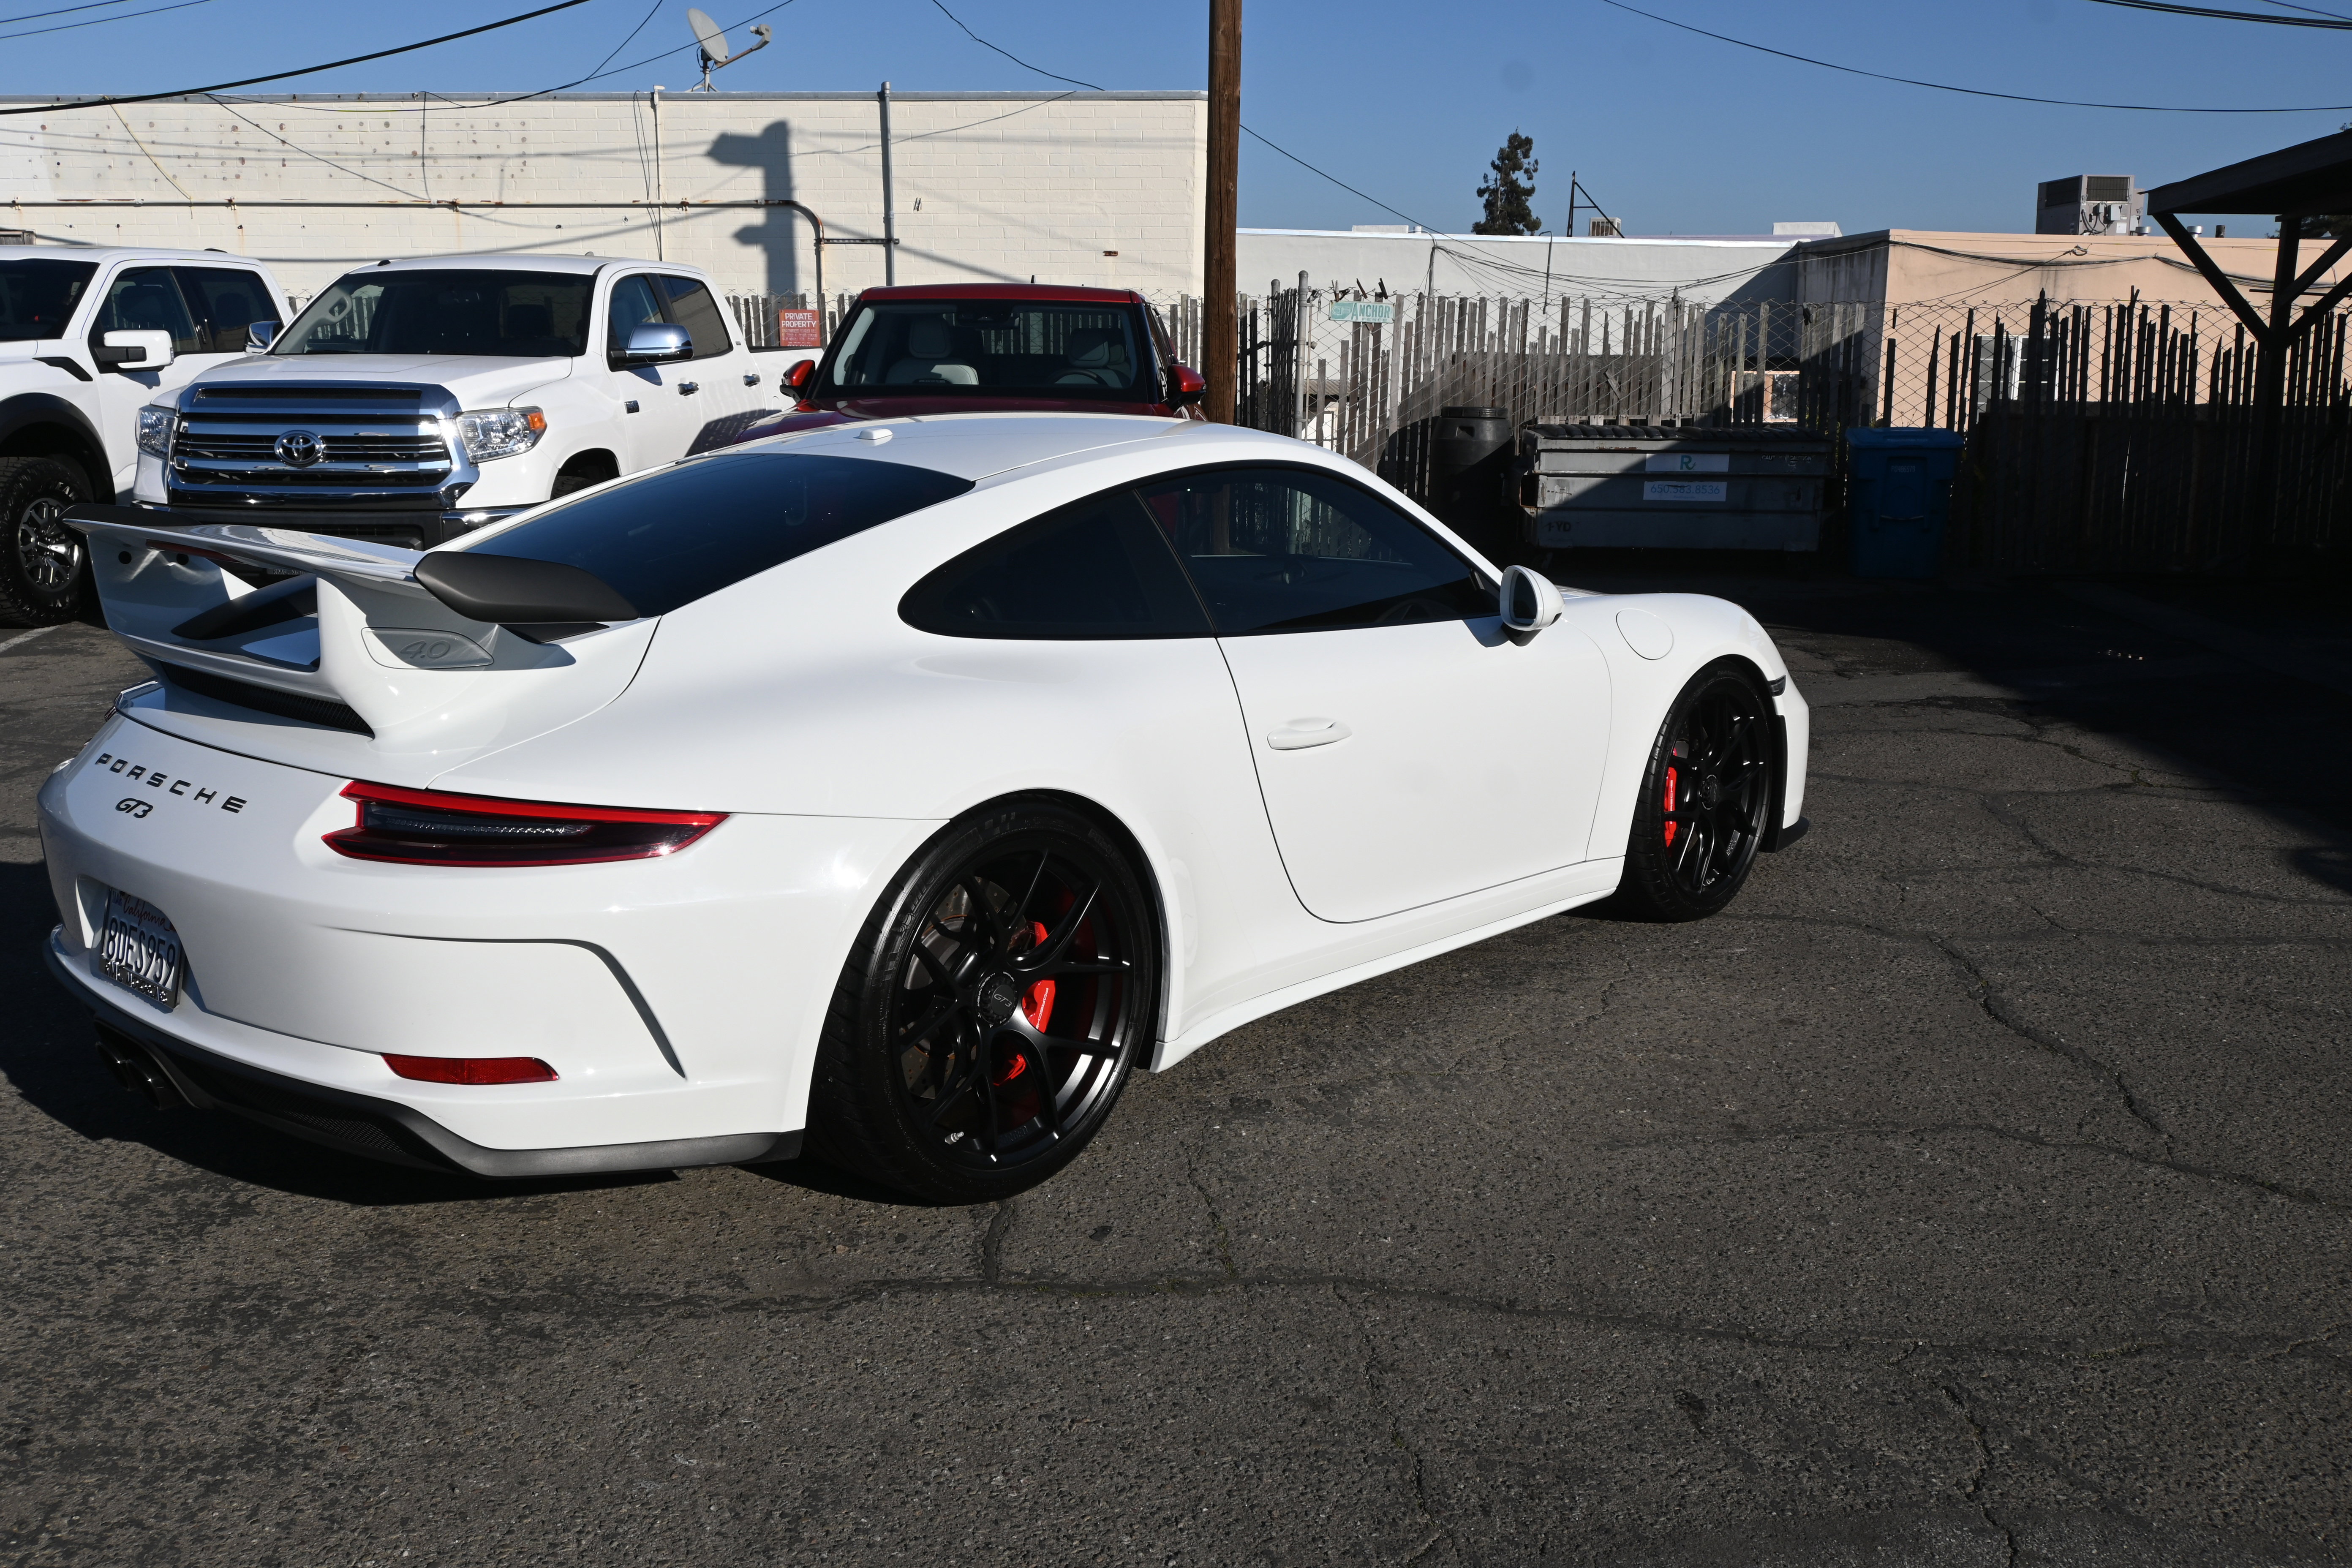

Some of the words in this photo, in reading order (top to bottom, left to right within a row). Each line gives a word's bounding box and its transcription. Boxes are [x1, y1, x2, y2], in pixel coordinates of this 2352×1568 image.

[1351, 302, 1391, 320] ANCHOR
[1650, 484, 1720, 495] 650.583.8536
[400, 640, 450, 659] 4.0
[95, 753, 247, 814] PORSCHE
[115, 798, 153, 819] GT3
[123, 896, 170, 932] California
[106, 917, 176, 986] 8DES959
[994, 994, 1013, 1007] GT3
